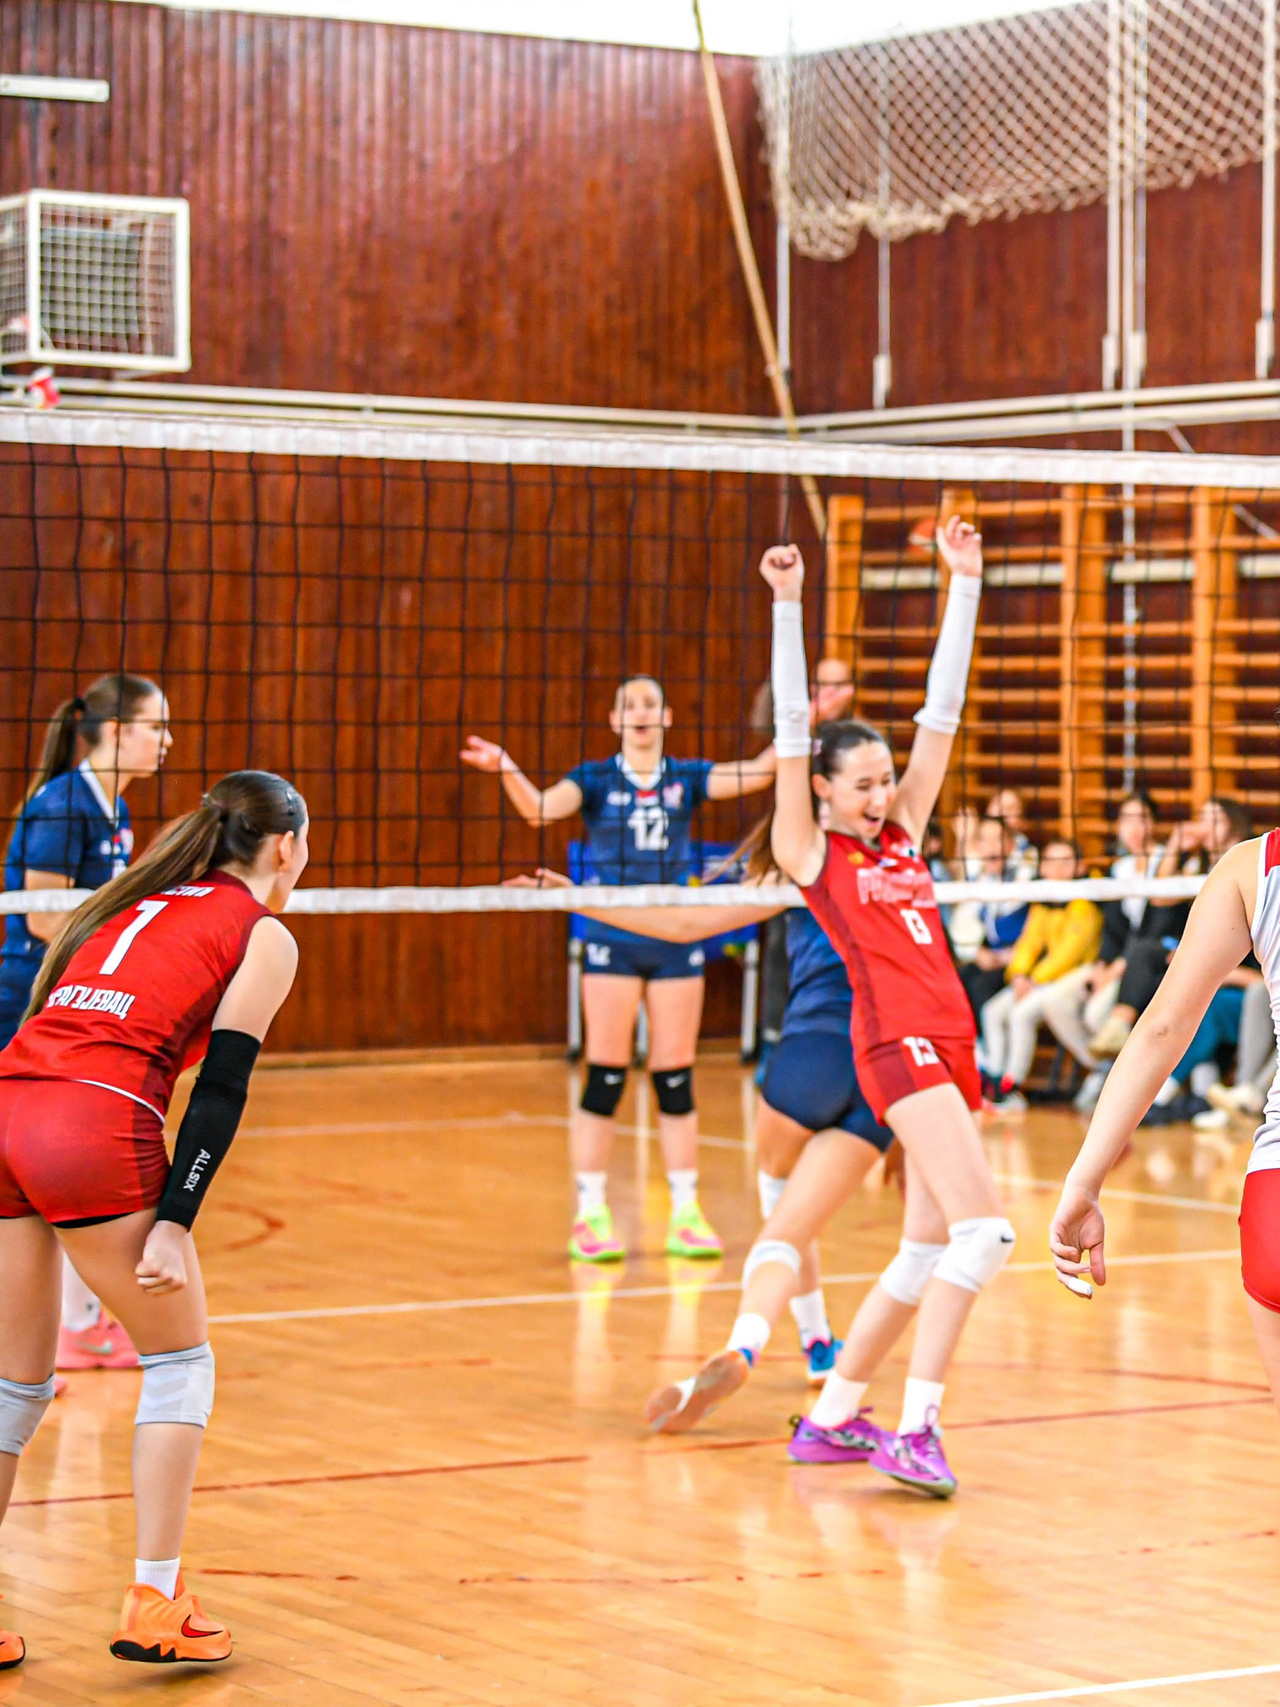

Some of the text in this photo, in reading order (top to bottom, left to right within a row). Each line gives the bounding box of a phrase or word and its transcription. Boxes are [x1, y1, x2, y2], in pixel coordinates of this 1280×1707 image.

[627, 806, 669, 851] 12
[99, 899, 169, 976] 1
[46, 985, 136, 1020] РАГУЈЕВАЦ
[902, 1035, 939, 1068] 13
[183, 1148, 211, 1192] ALLSIX
